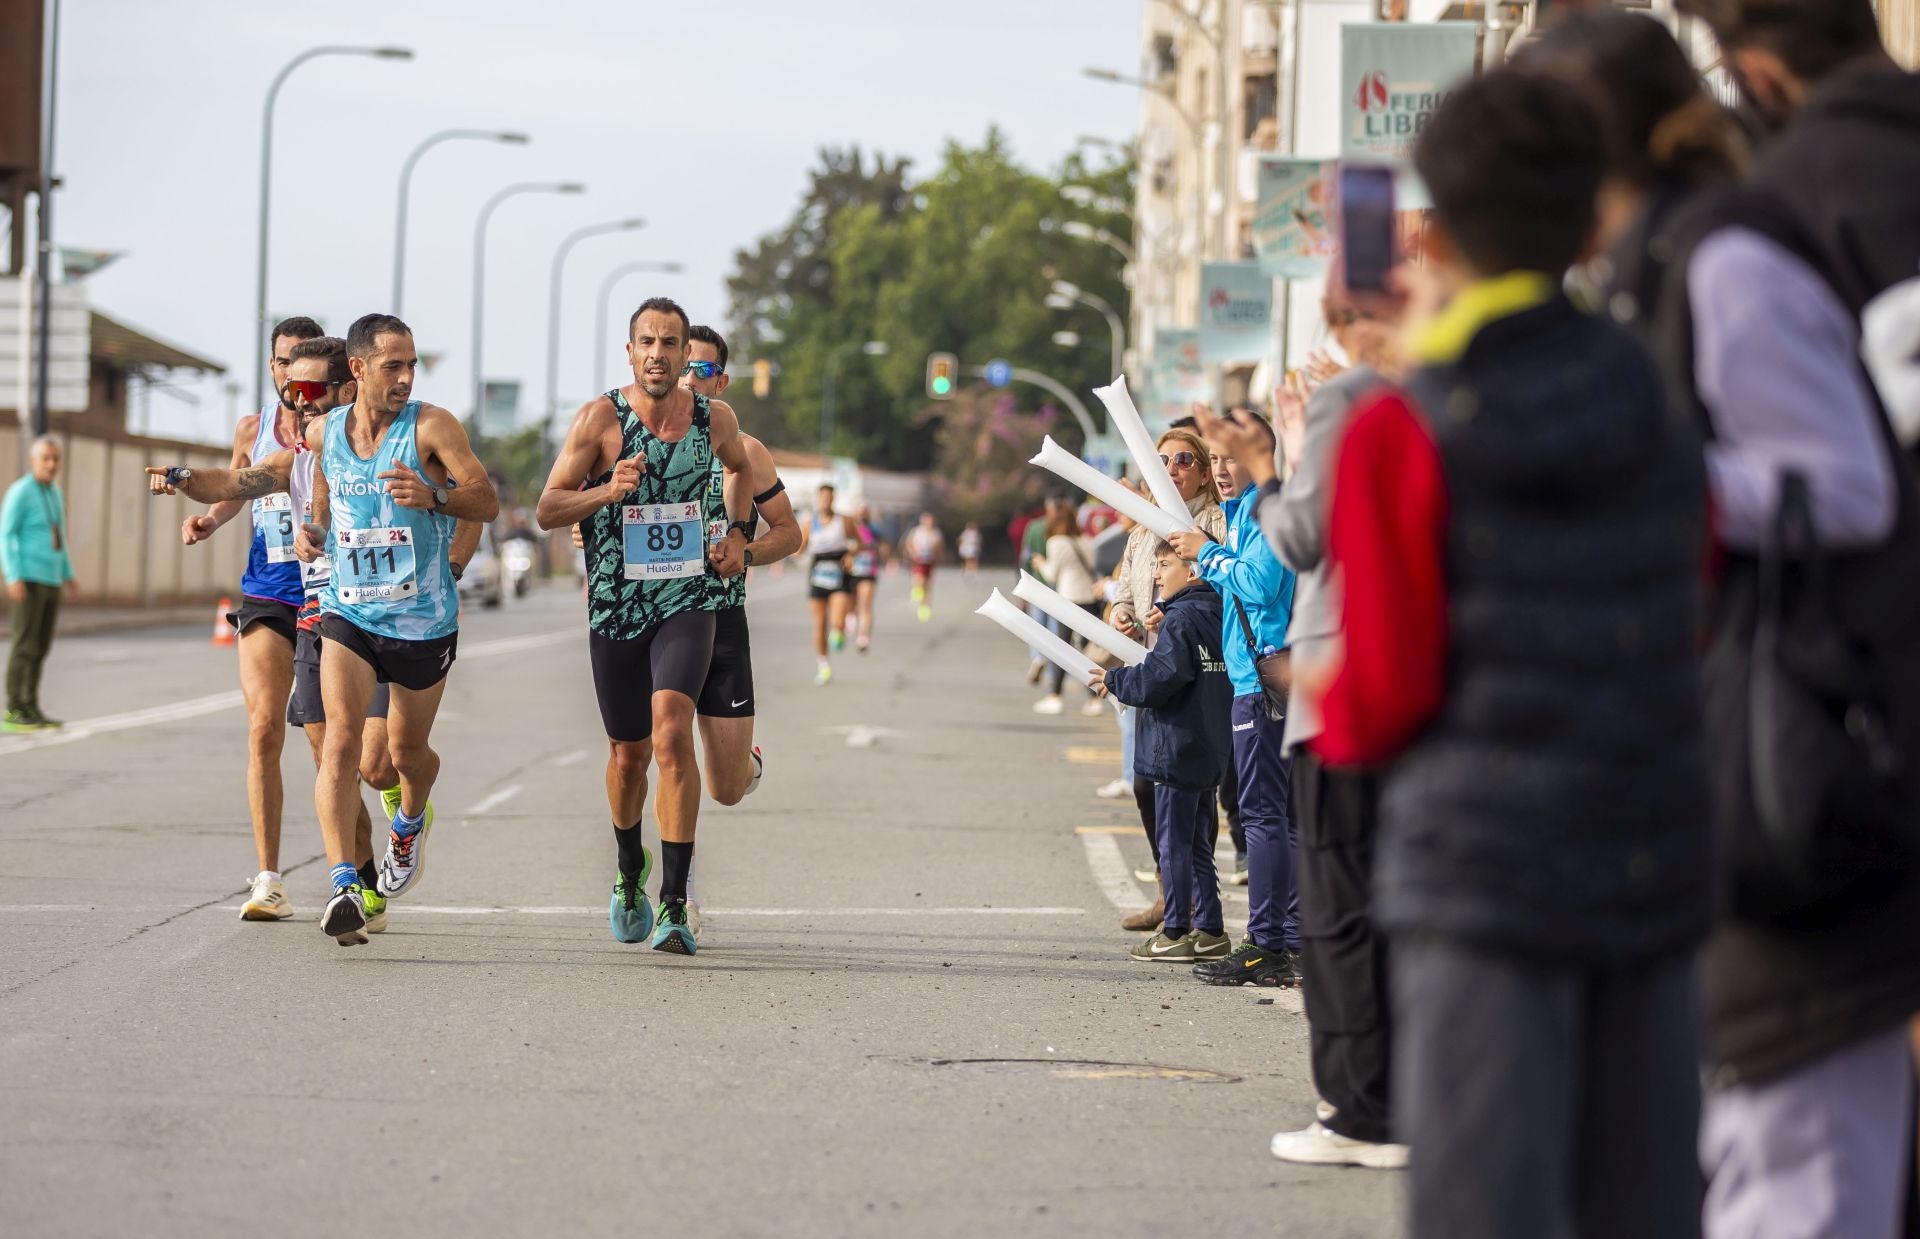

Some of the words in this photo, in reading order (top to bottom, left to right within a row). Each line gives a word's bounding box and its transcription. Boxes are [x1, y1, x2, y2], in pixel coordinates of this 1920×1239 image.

[1366, 112, 1431, 137] LIBR
[647, 524, 684, 551] 89
[347, 547, 395, 576] 111
[647, 564, 682, 573] Huelva
[356, 587, 390, 597] Huelva
